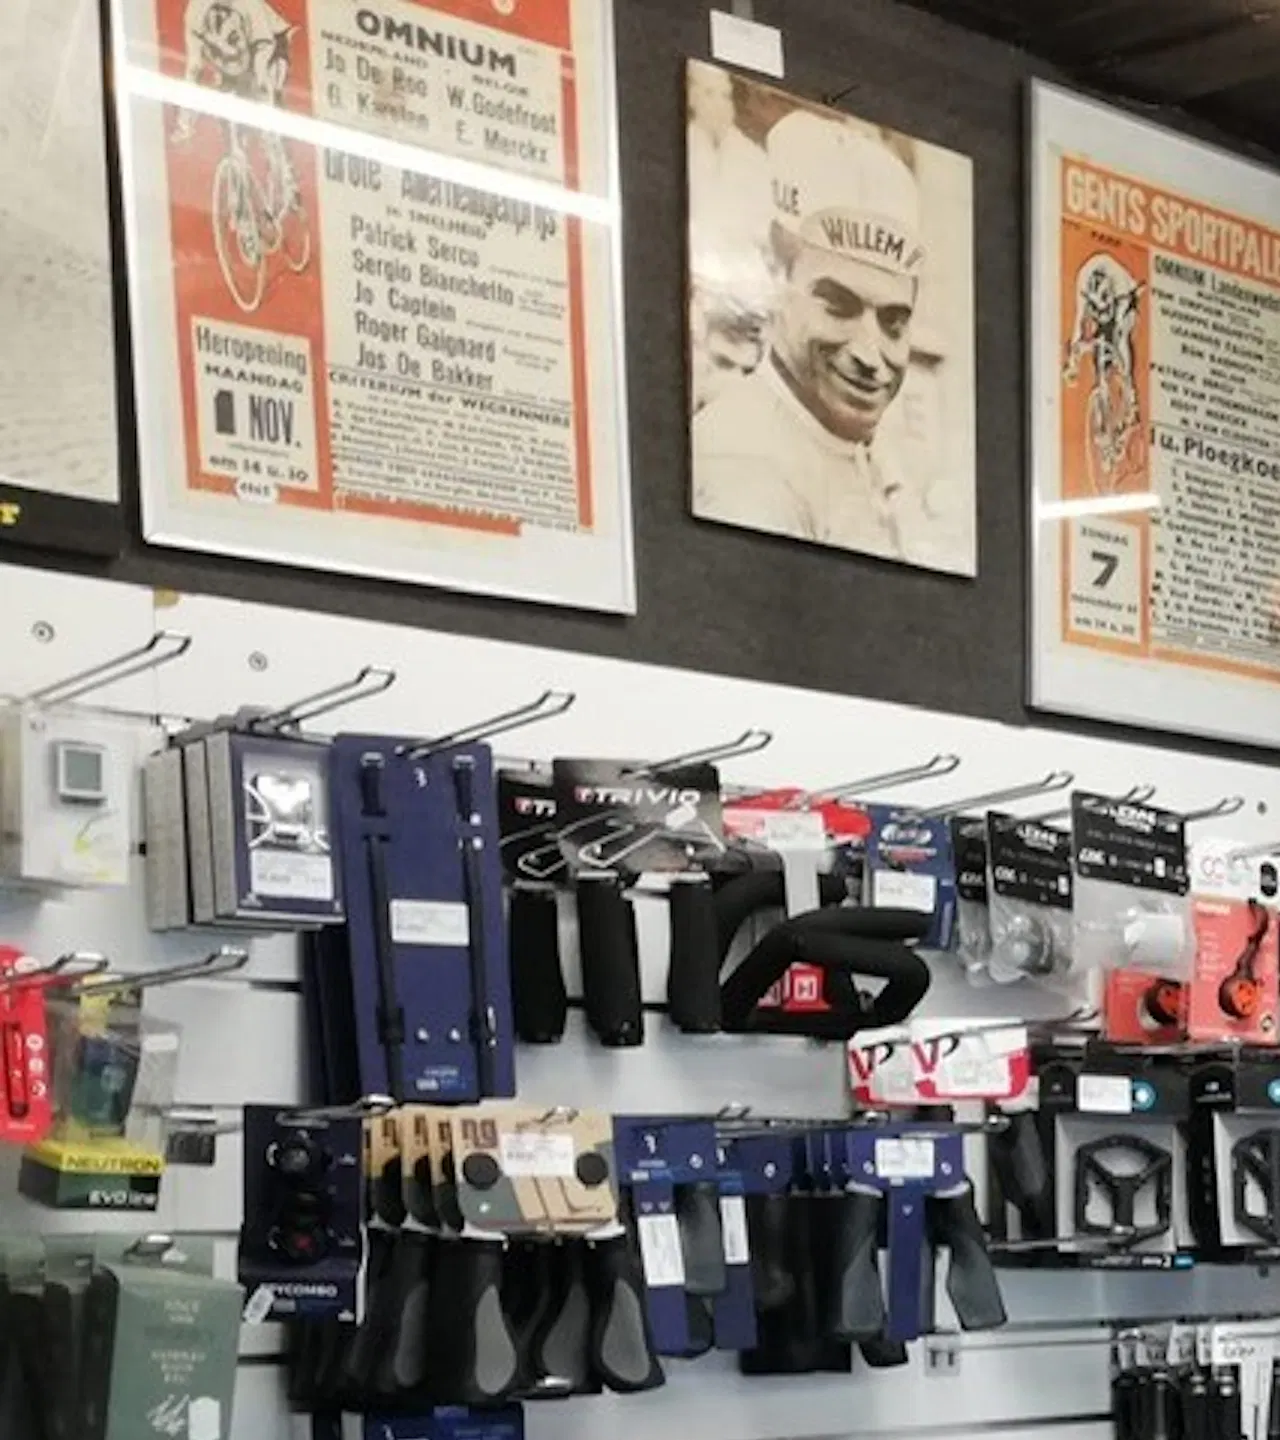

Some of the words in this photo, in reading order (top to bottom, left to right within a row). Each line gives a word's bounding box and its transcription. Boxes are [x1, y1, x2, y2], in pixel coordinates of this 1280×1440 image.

[355, 8, 518, 78] OMNIUM
[1065, 166, 1148, 238] GENTS
[350, 214, 418, 253] Patrick
[351, 249, 412, 283] Sergio
[354, 309, 409, 344] Roger
[196, 324, 309, 377] Heropening
[356, 342, 388, 370] Jos
[397, 351, 422, 379] De
[431, 358, 494, 393] Bakker
[204, 362, 304, 394] MAANDAG
[1090, 549, 1120, 590] 7
[593, 786, 702, 806] TRIVIO
[65, 1153, 161, 1172] NEUTRON
